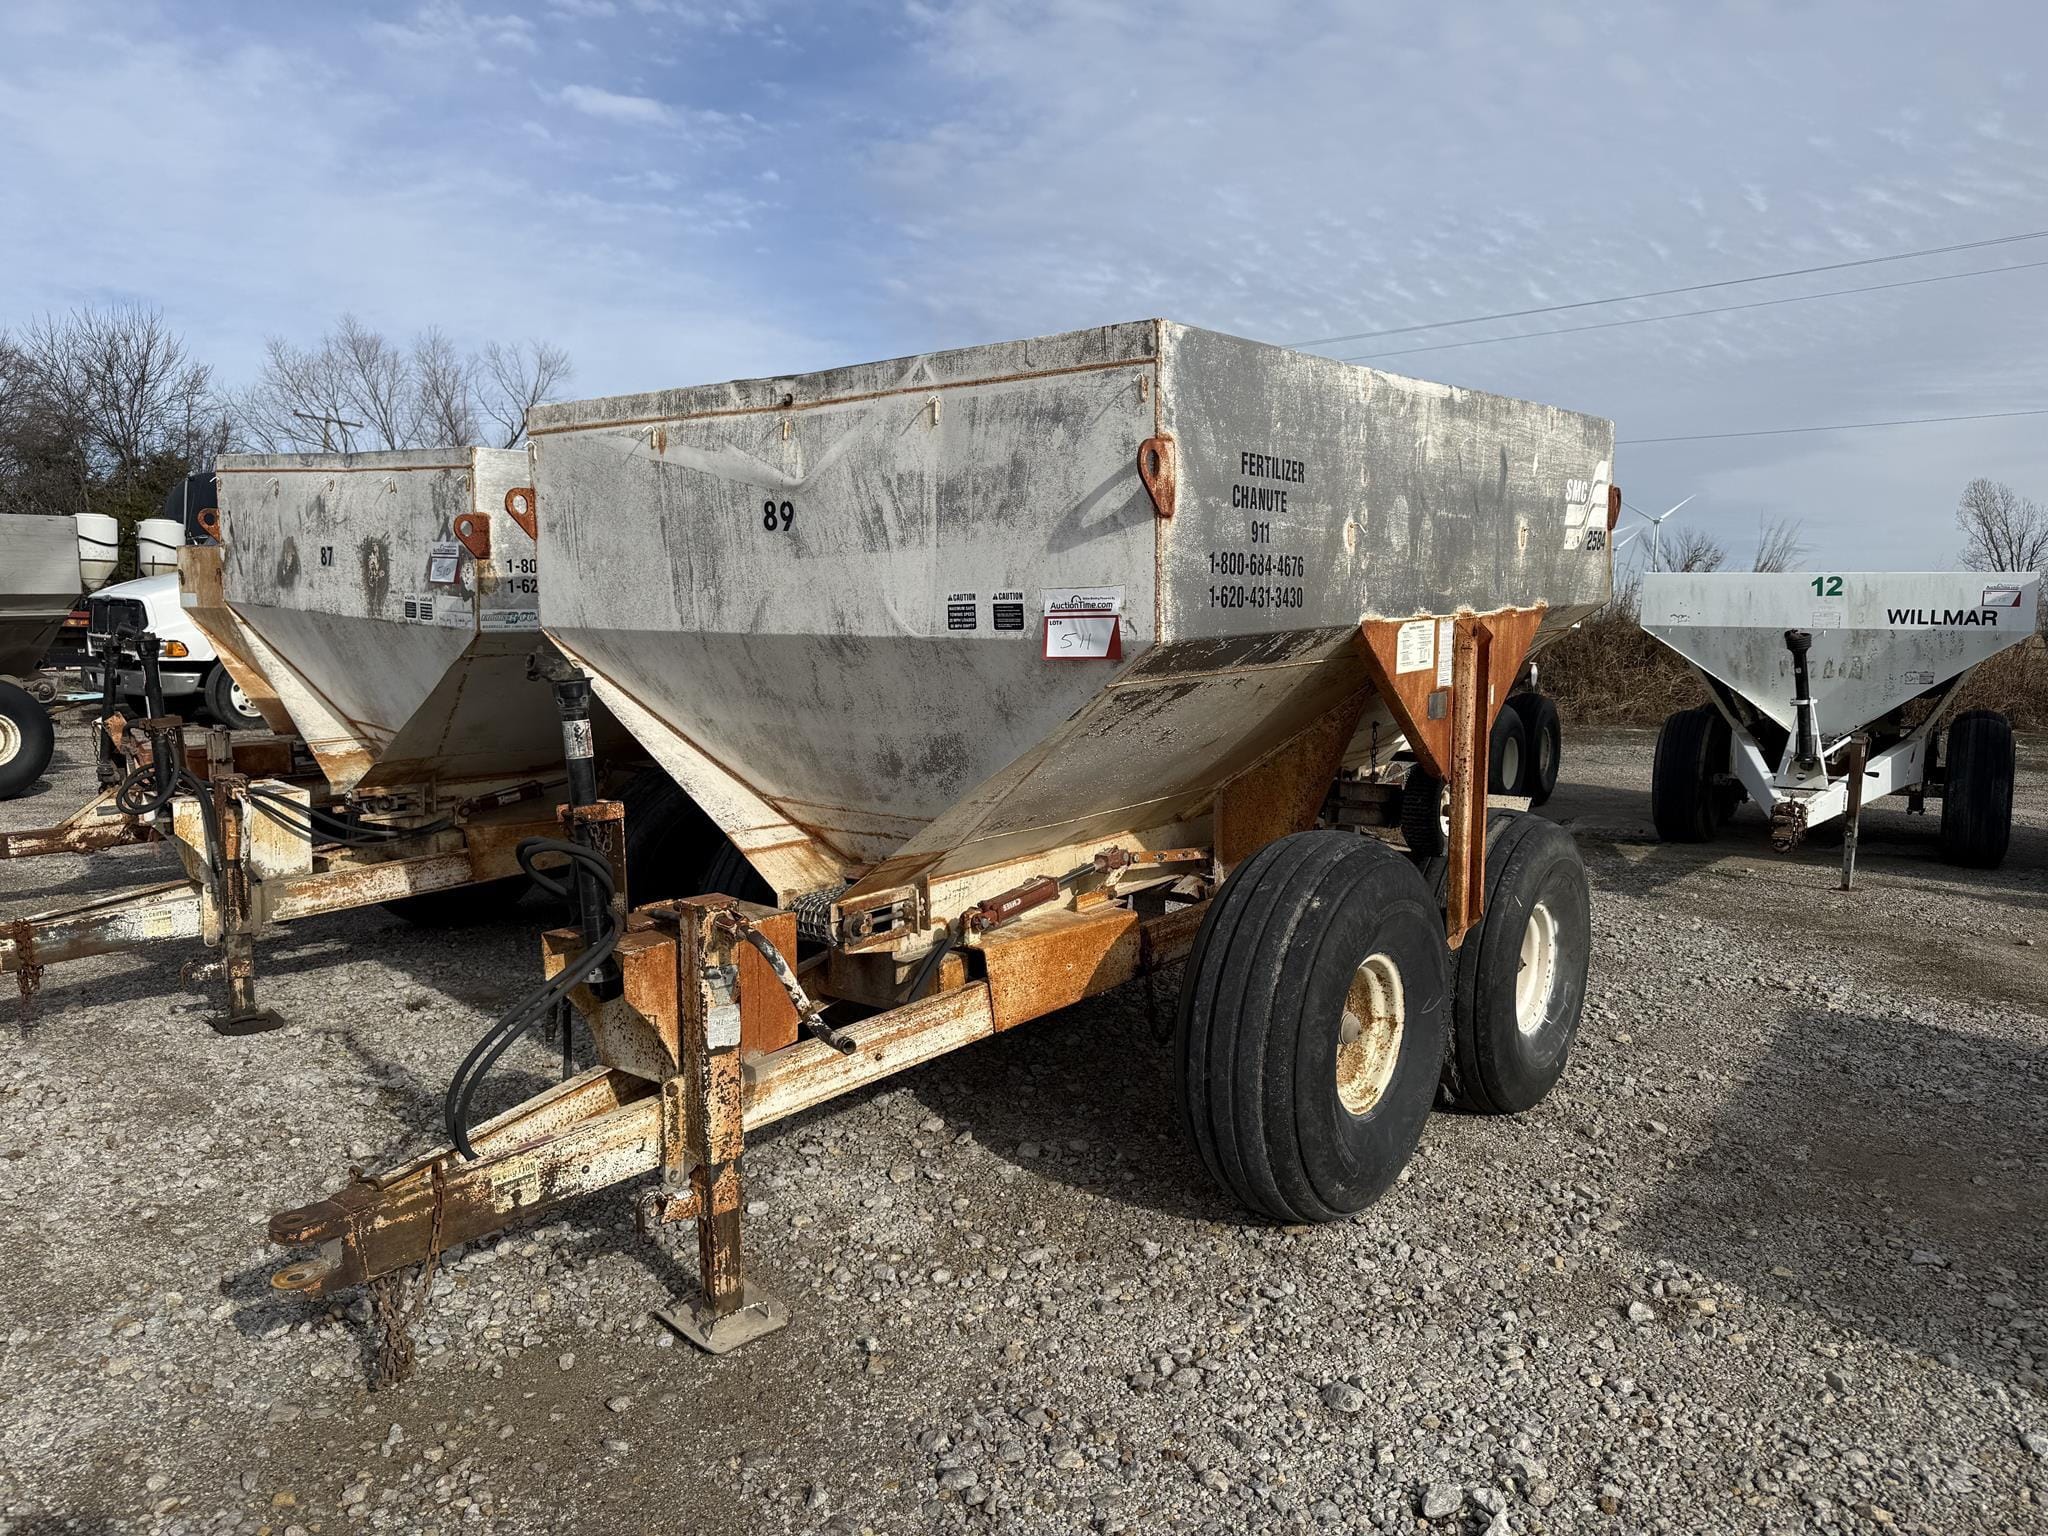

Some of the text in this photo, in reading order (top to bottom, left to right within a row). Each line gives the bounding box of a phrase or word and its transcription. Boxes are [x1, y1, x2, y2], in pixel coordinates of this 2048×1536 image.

[1241, 451, 1305, 484] FERTILIZER
[1232, 484, 1288, 513] CHANUTE
[763, 500, 794, 531] 89
[1251, 520, 1270, 544] 911
[320, 546, 333, 566] 87
[1209, 551, 1304, 578] 1-800-684-4676
[953, 593, 976, 601] CAUTION
[998, 592, 1023, 601] CAUTION
[1209, 585, 1303, 609] 1-620-431-3430
[1811, 576, 1843, 597] 12
[1050, 601, 1113, 609] AuctionTime.com
[1887, 608, 1998, 626] WILLMAR
